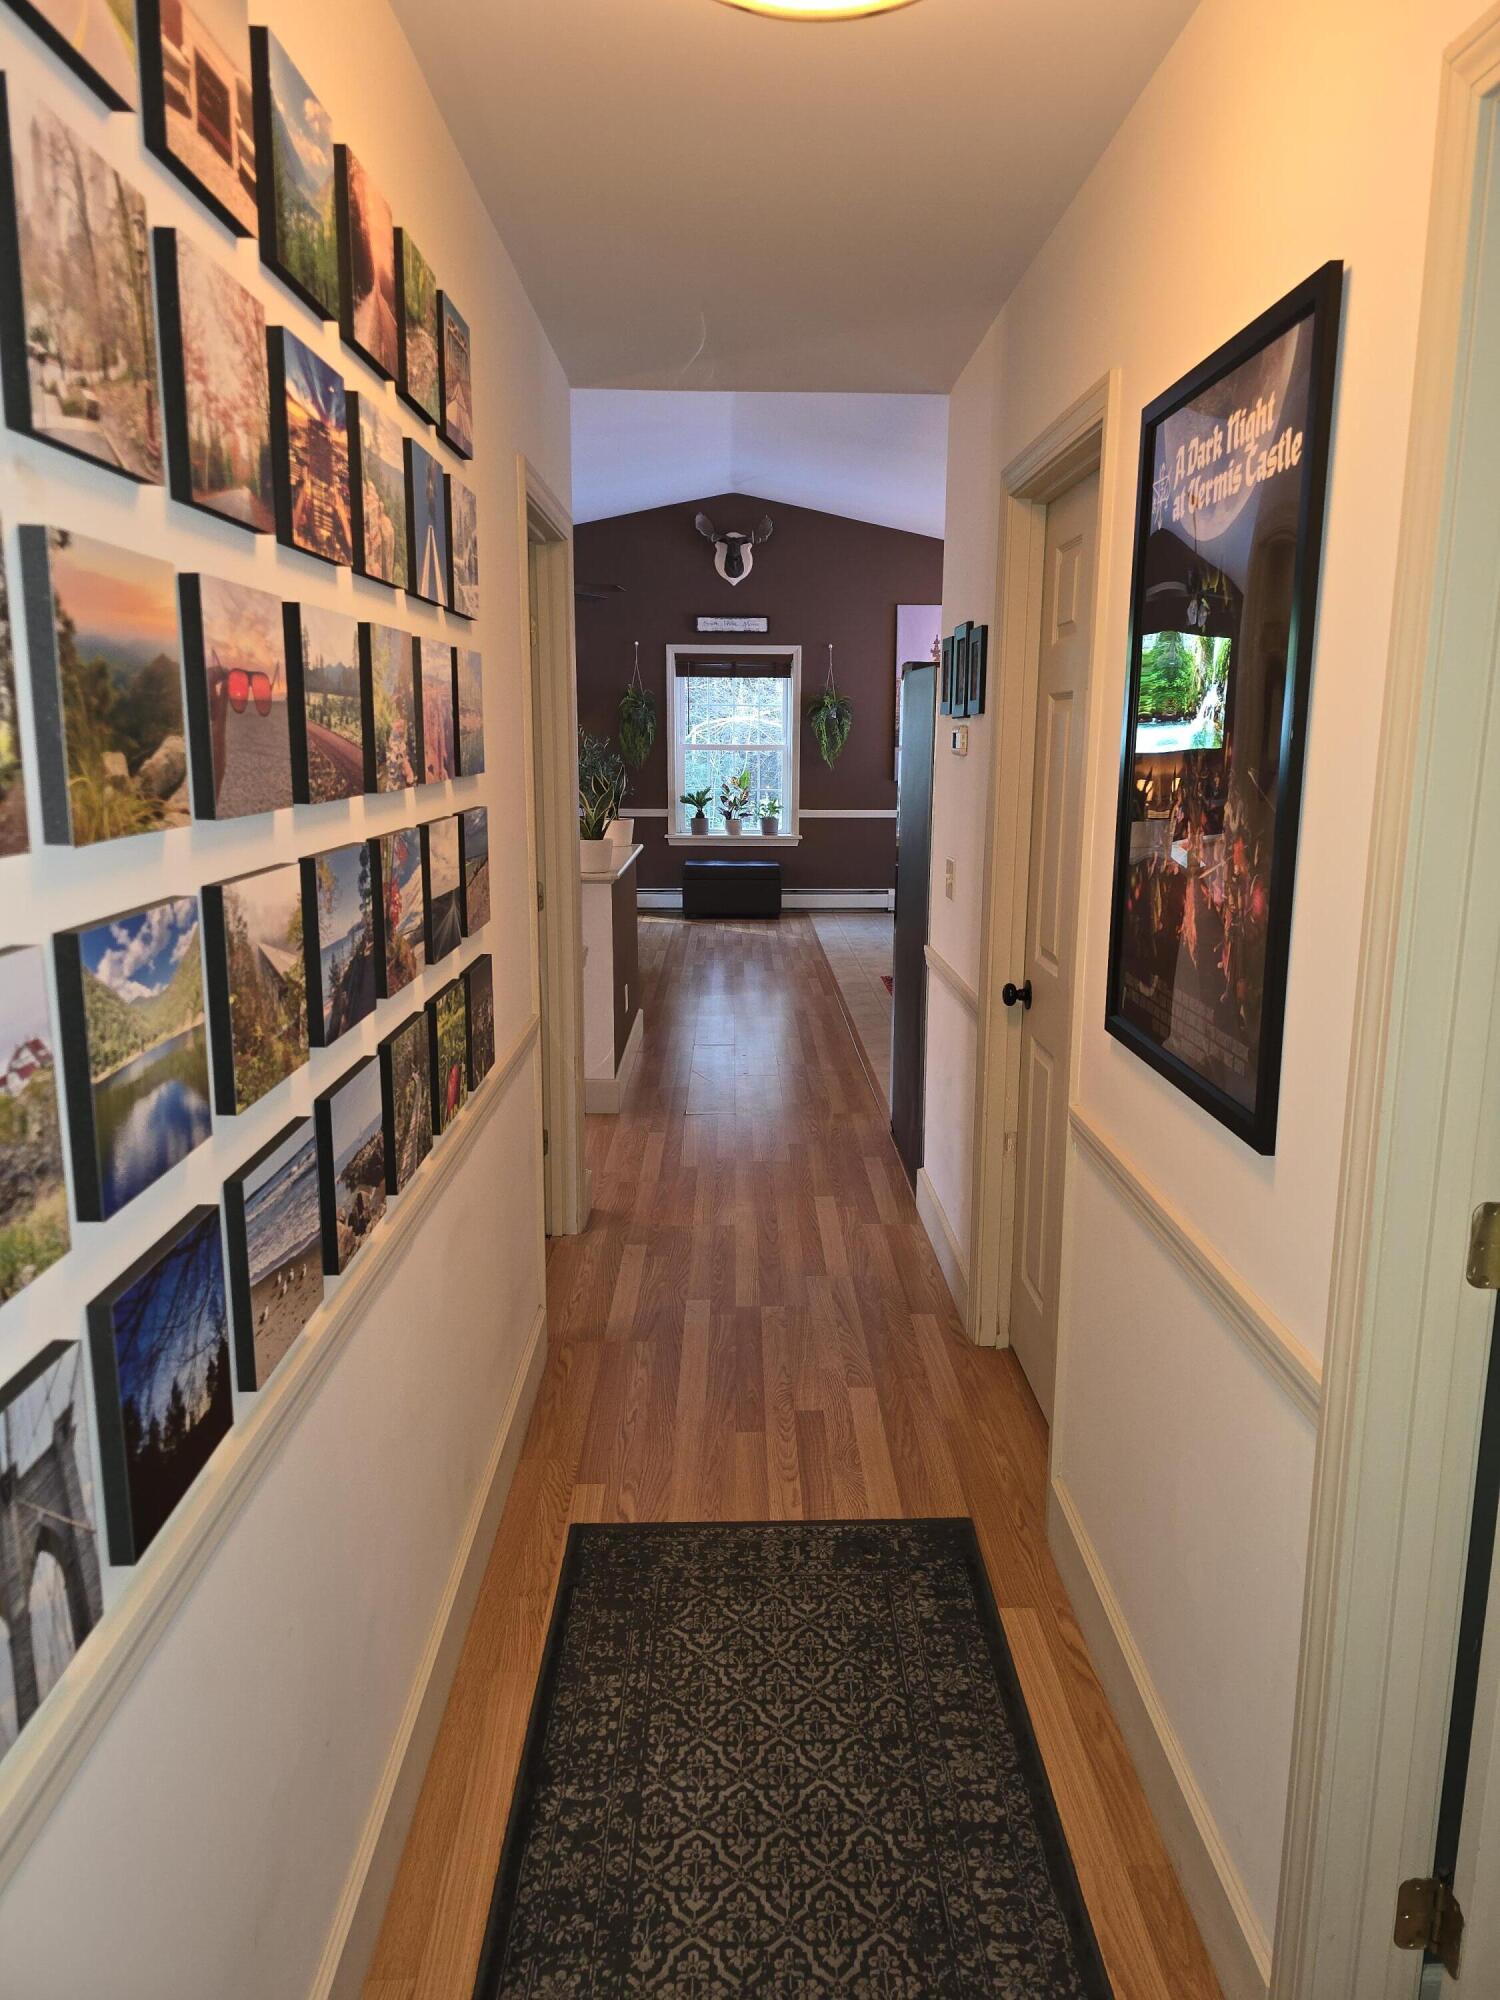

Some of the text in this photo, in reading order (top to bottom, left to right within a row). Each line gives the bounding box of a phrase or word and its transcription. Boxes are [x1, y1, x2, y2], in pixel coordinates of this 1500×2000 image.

[1172, 486, 1186, 522] at
[1244, 426, 1304, 487] Castle
[1173, 391, 1275, 489] A Dark Night
